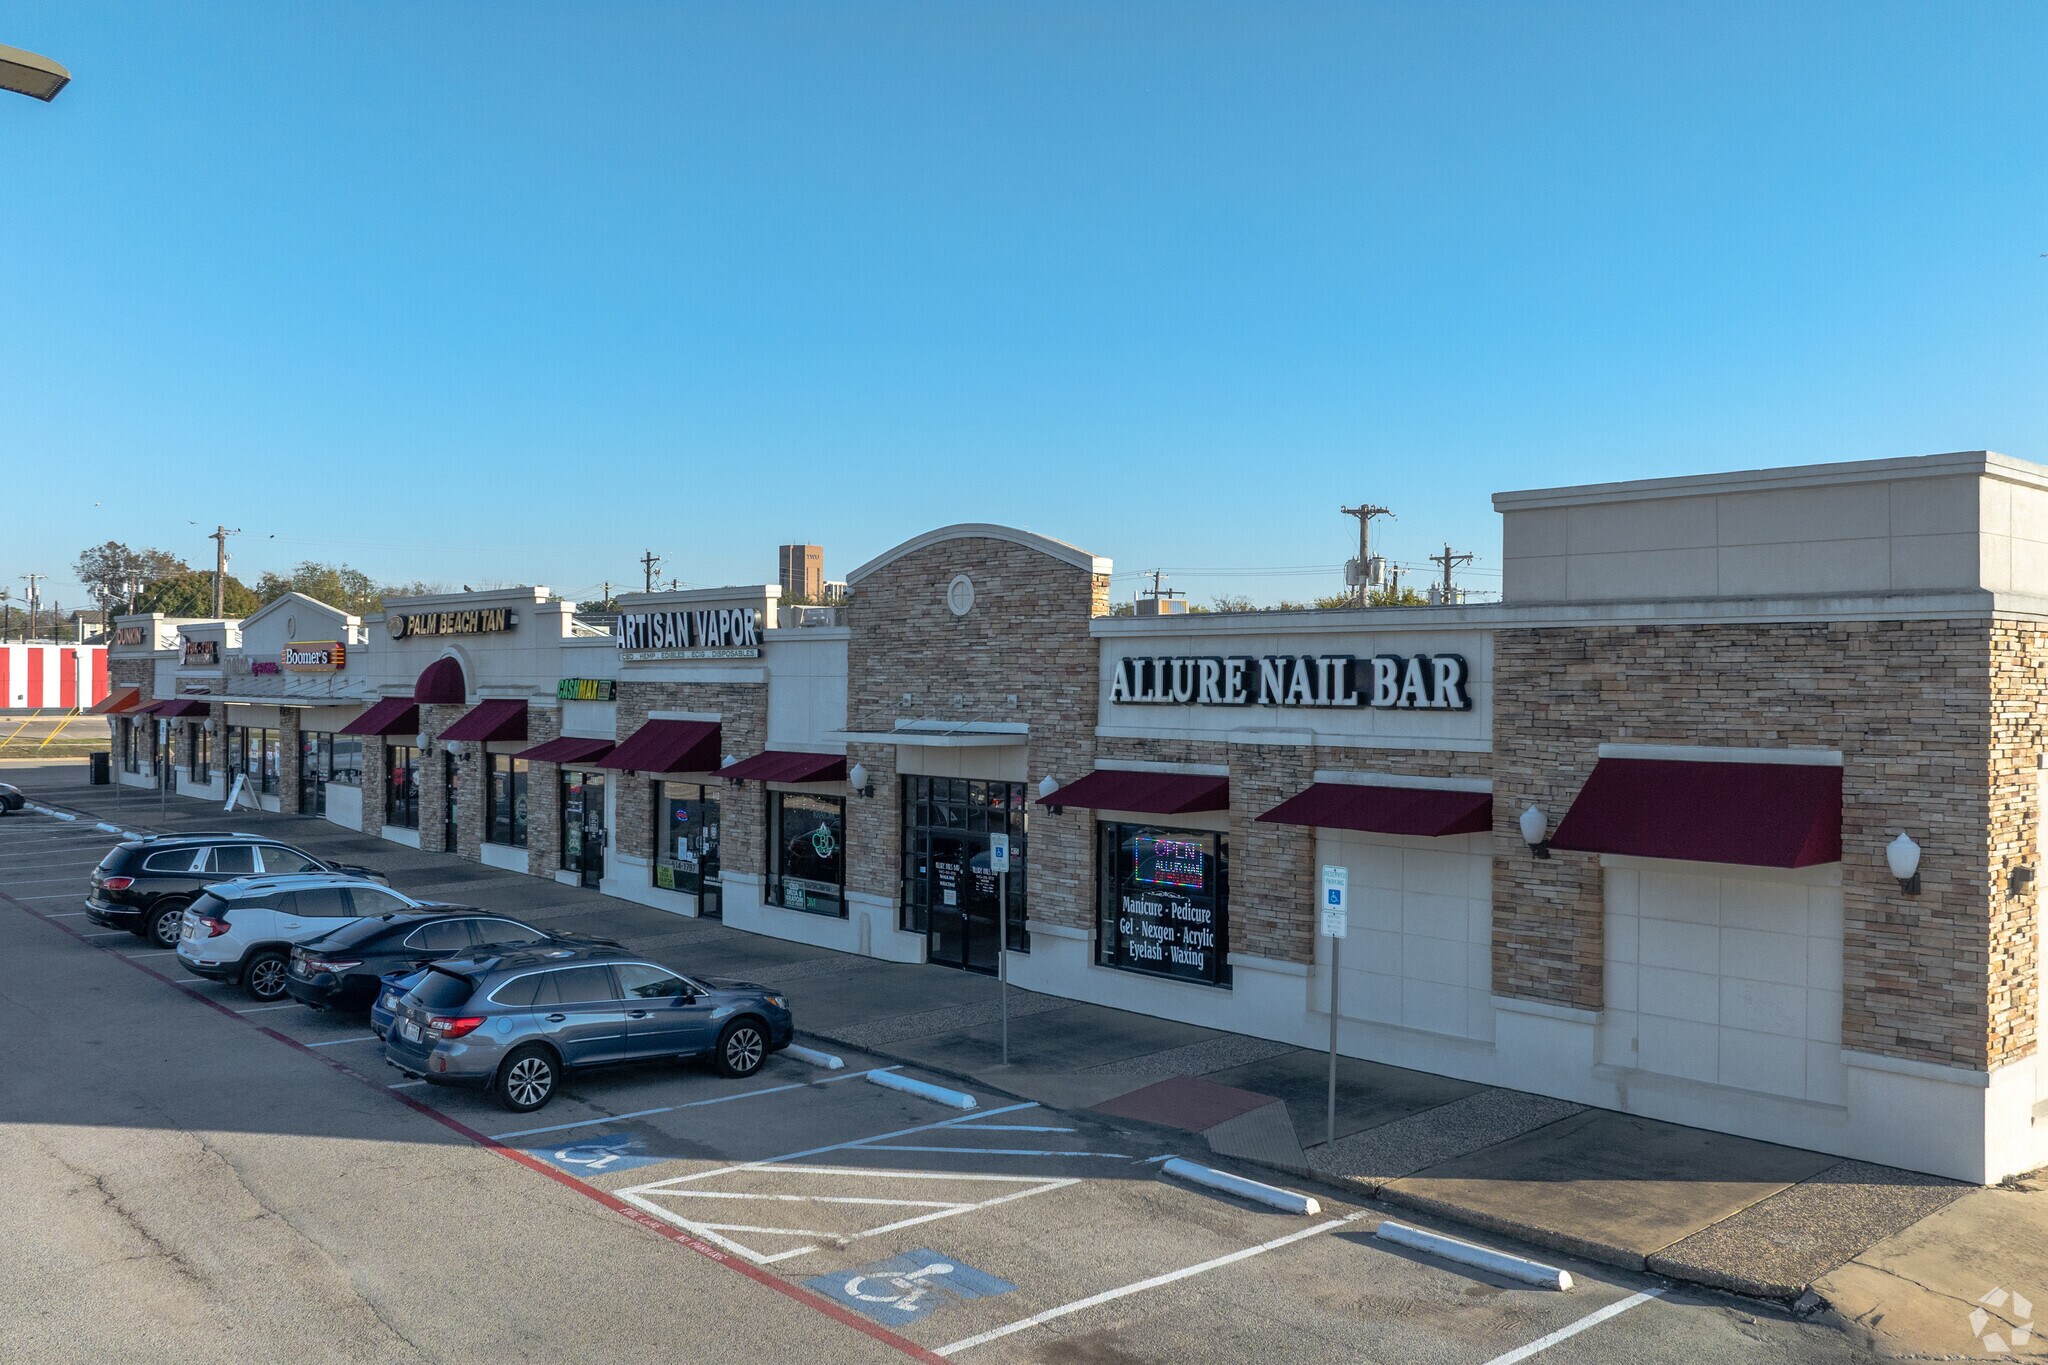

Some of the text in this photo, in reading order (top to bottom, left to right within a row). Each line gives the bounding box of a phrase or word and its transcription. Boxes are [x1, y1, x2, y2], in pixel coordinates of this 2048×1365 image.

[407, 608, 506, 636] PALM BEACH TAN
[616, 608, 758, 649] ARTISAN VAPOR
[285, 648, 328, 665] Boomer's
[621, 649, 755, 661] CBD HEMP EDIBLES ECIG DISPOSABLES
[1108, 656, 1467, 708] ALLURE NAIL BAR
[812, 833, 835, 850] CBD
[1122, 896, 1211, 924] Manicure Pedicure
[1120, 918, 1214, 949] Gel Nexgen Acrylic
[1129, 940, 1204, 971] Eyelash Waxing
